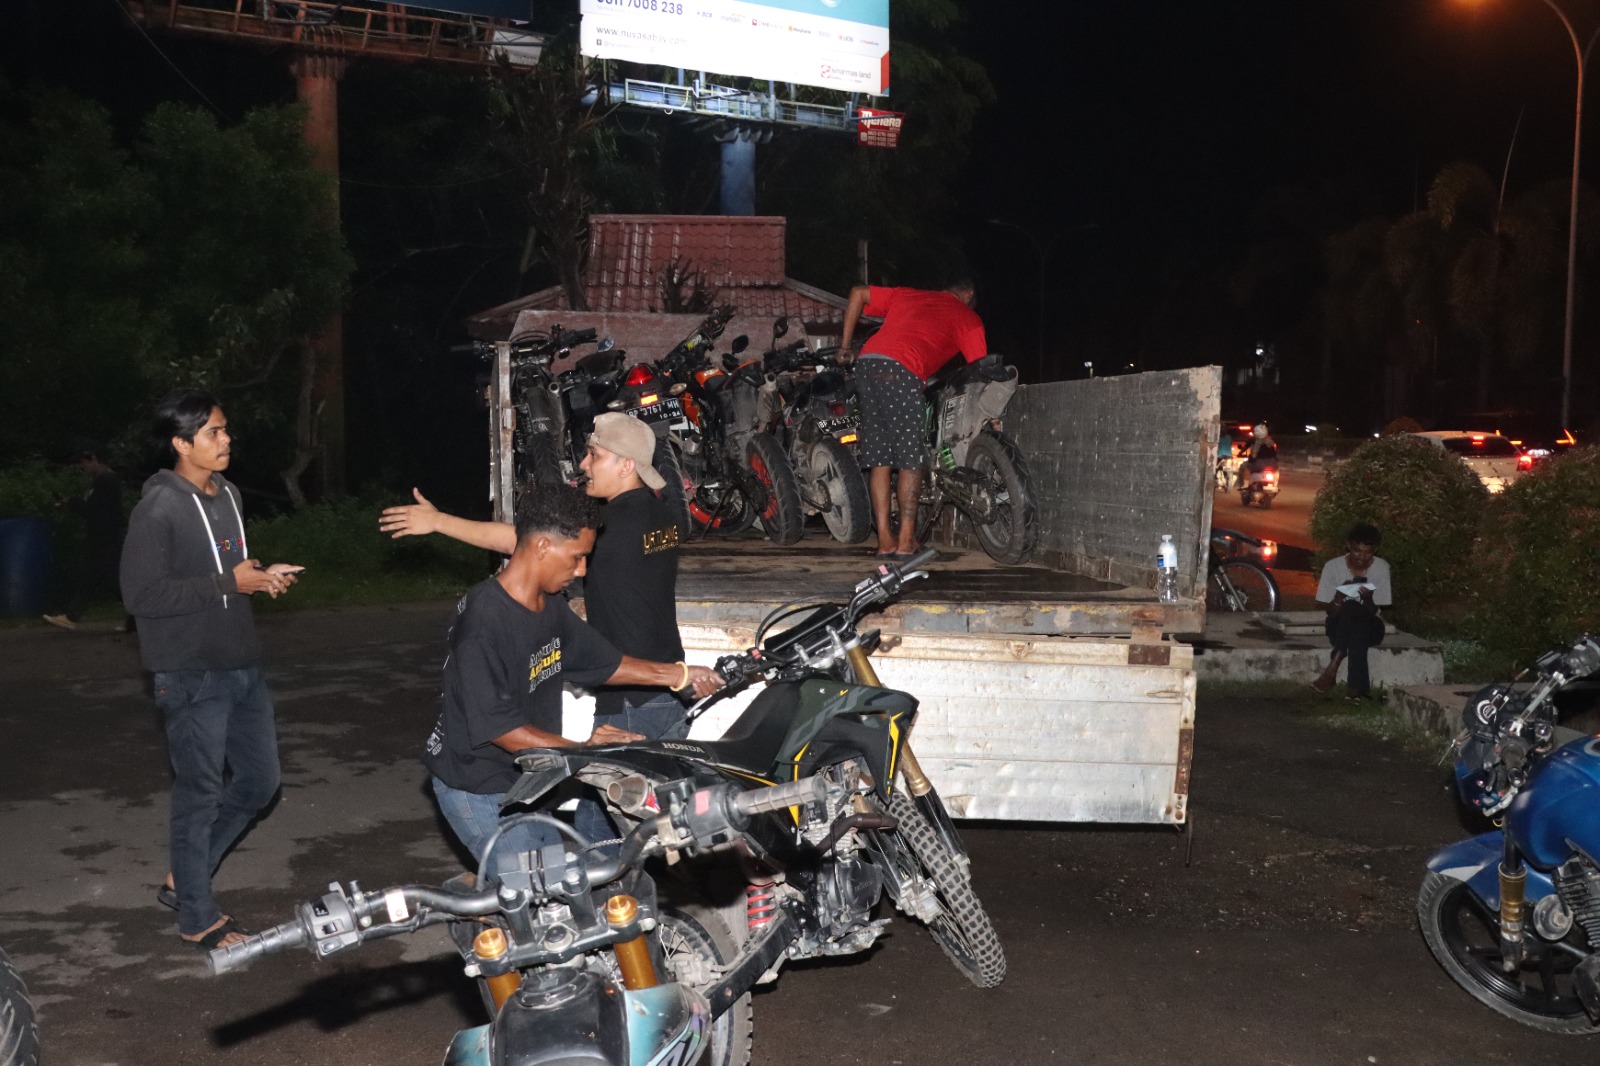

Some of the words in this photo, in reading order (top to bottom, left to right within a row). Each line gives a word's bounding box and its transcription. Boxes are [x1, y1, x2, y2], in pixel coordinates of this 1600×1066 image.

[661, 1, 684, 16] 238
[642, 404, 662, 417] 3767
[661, 742, 706, 754] HONDA
